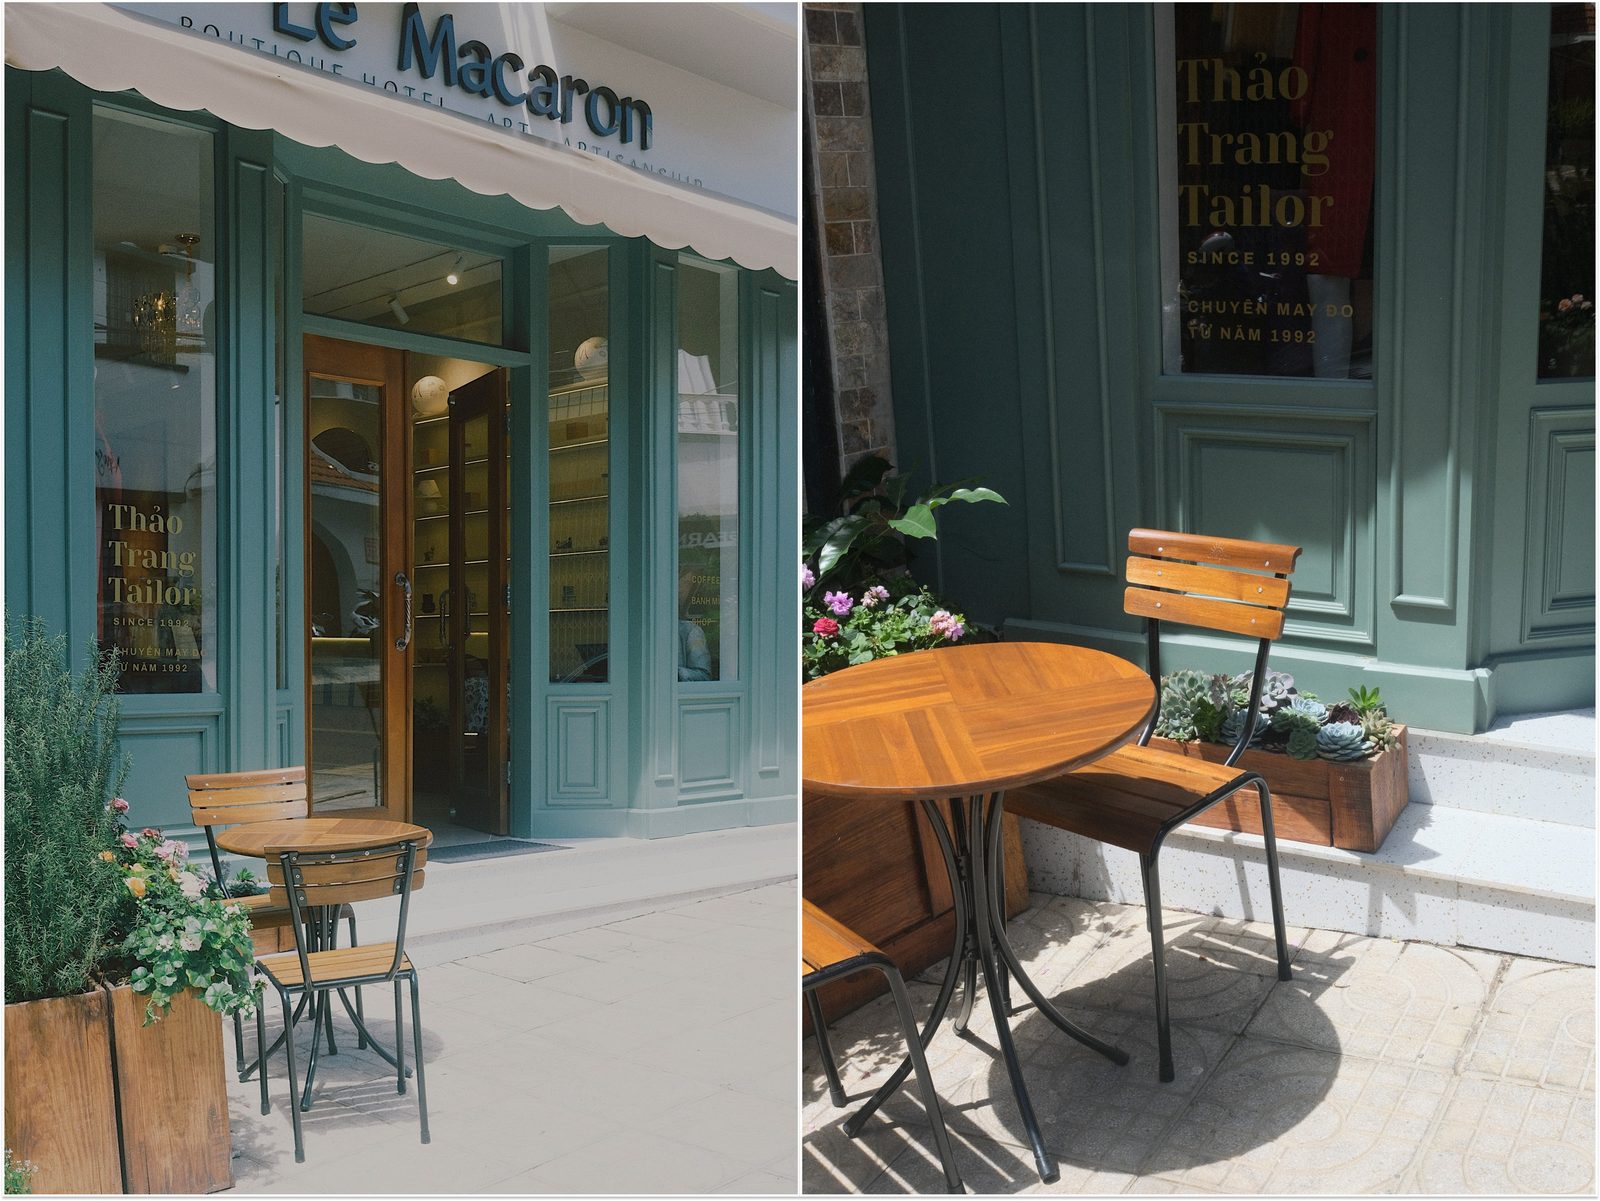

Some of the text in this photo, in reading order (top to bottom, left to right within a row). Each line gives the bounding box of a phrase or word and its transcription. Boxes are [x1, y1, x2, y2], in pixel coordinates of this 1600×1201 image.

[272, 2, 653, 151] Le Macaron
[1177, 51, 1309, 103] Thảo
[1177, 122, 1335, 176] Trang
[1177, 184, 1335, 228] Tailor
[1187, 251, 1320, 267] SINCE 1992
[1187, 298, 1268, 315] CHUYÊN
[1277, 303, 1318, 317] MAY
[1220, 325, 1262, 342] NĂM
[1270, 329, 1317, 345] 1992
[108, 503, 183, 535] Thảo
[108, 540, 196, 577] Trang
[107, 577, 197, 606] Tailor
[691, 575, 720, 584] COFFEE
[113, 617, 190, 628] SINCE 1992
[117, 646, 161, 657] HUYÊN
[166, 648, 188, 657] MAY
[132, 661, 158, 673] NĂM
[162, 664, 188, 673] 1992
